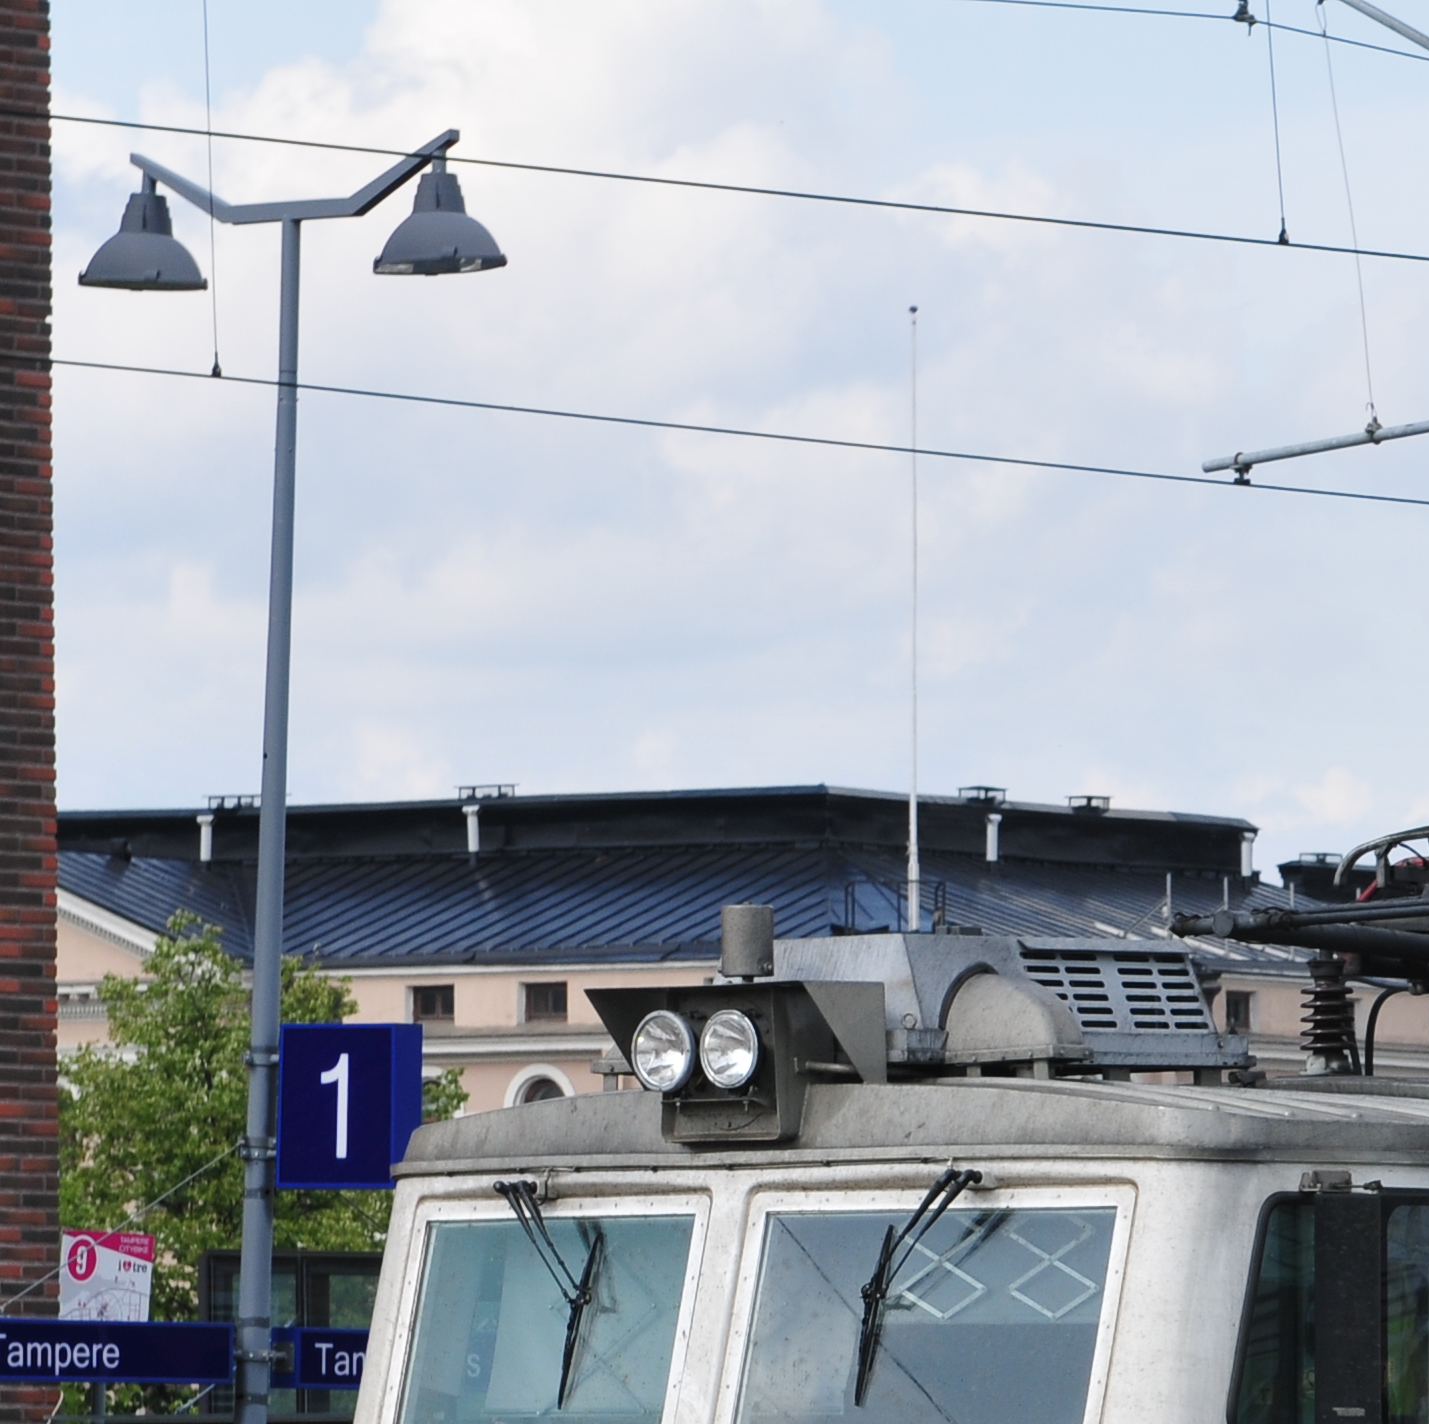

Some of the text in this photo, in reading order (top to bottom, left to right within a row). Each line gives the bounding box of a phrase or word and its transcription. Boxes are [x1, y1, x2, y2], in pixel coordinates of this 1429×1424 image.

[320, 1052, 349, 1159] 1
[75, 1245, 88, 1275] 9
[0, 1333, 120, 1377] ampere
